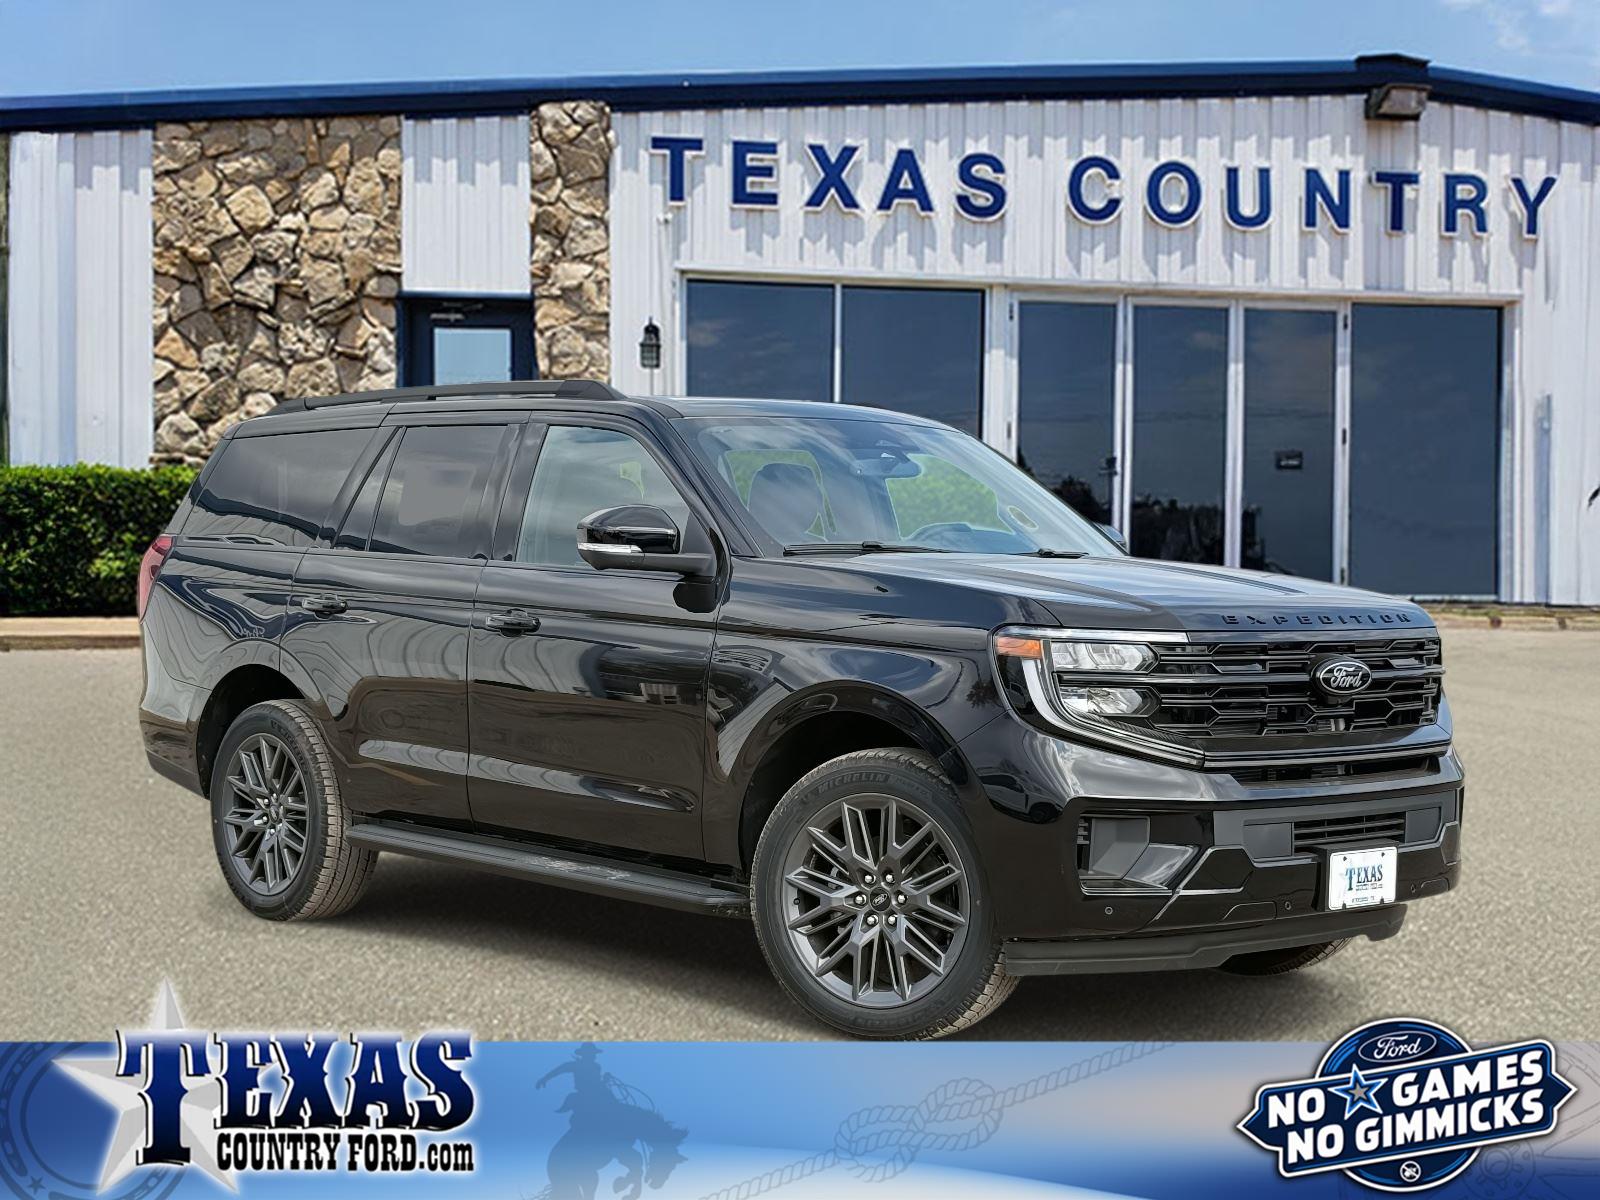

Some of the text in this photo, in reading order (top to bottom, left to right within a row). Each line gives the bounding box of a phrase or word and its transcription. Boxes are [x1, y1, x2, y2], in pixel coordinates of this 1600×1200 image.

[650, 134, 1557, 238] TEXAS COUNTRY
[1222, 613, 1412, 625] EXPEDITION
[1331, 666, 1363, 688] Ford
[1345, 864, 1384, 891] TEXAS
